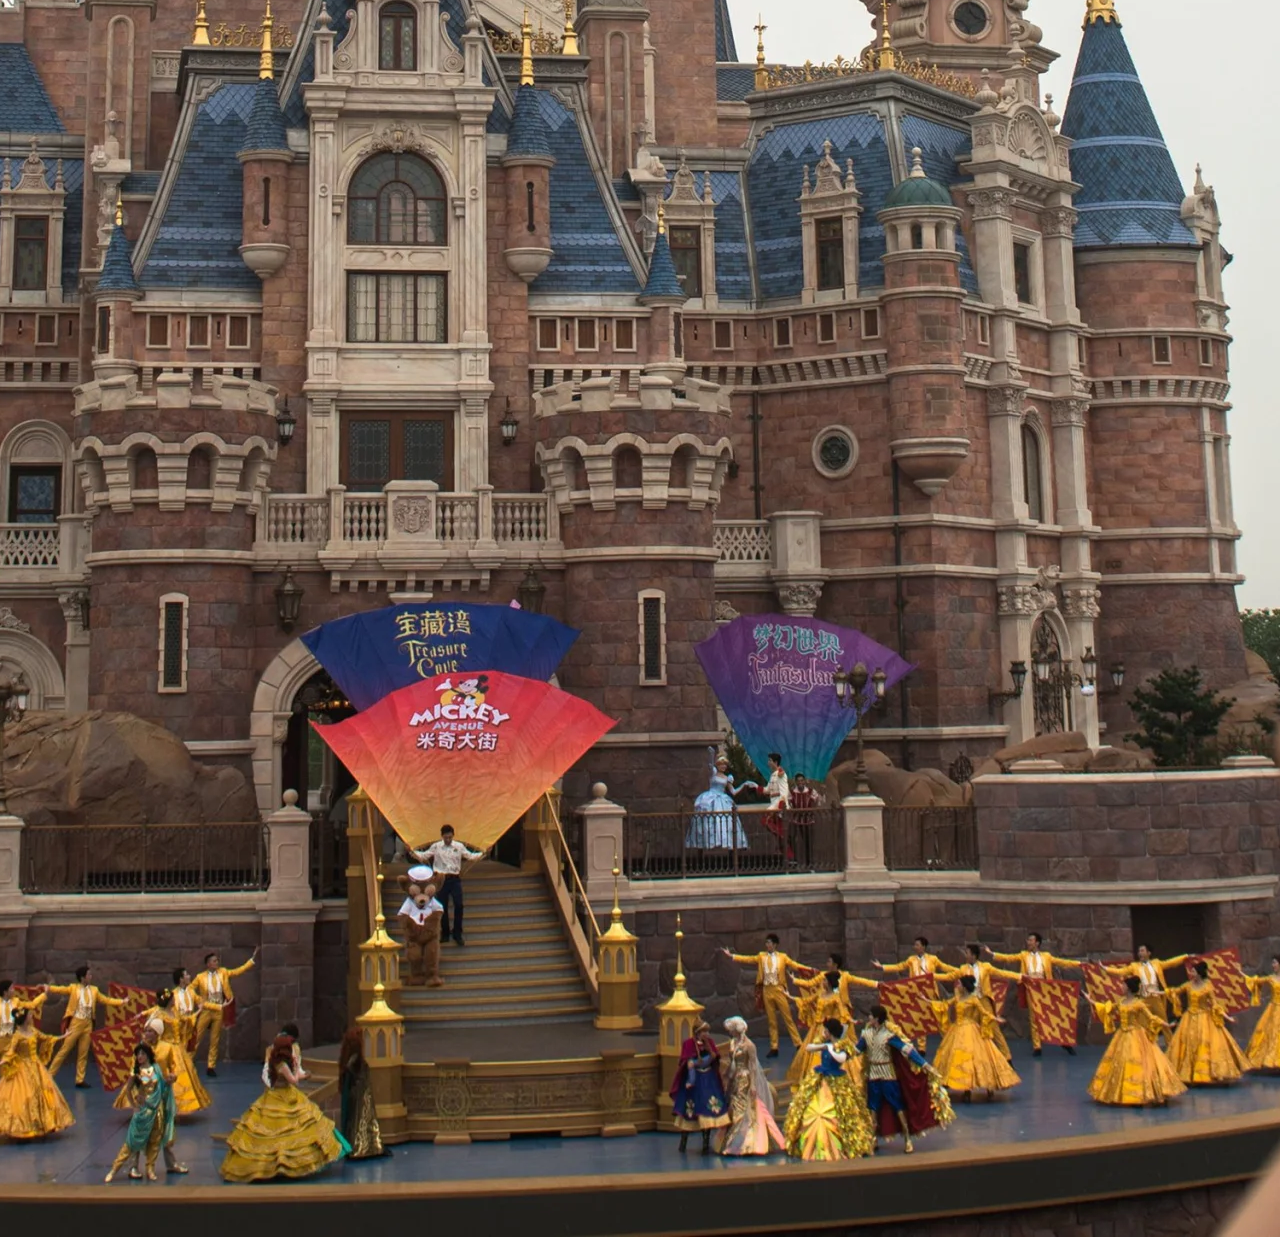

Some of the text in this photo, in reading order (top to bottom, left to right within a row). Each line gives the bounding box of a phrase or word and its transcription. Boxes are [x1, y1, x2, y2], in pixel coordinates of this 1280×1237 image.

[394, 610, 472, 640] 宝藏湾
[400, 640, 468, 668] Treasure
[753, 624, 844, 664] 梦幻世界
[416, 658, 458, 679] Cove
[409, 703, 510, 726] MICKEY
[432, 722, 485, 731] AVENUE
[416, 731, 497, 751] 米奇大街
